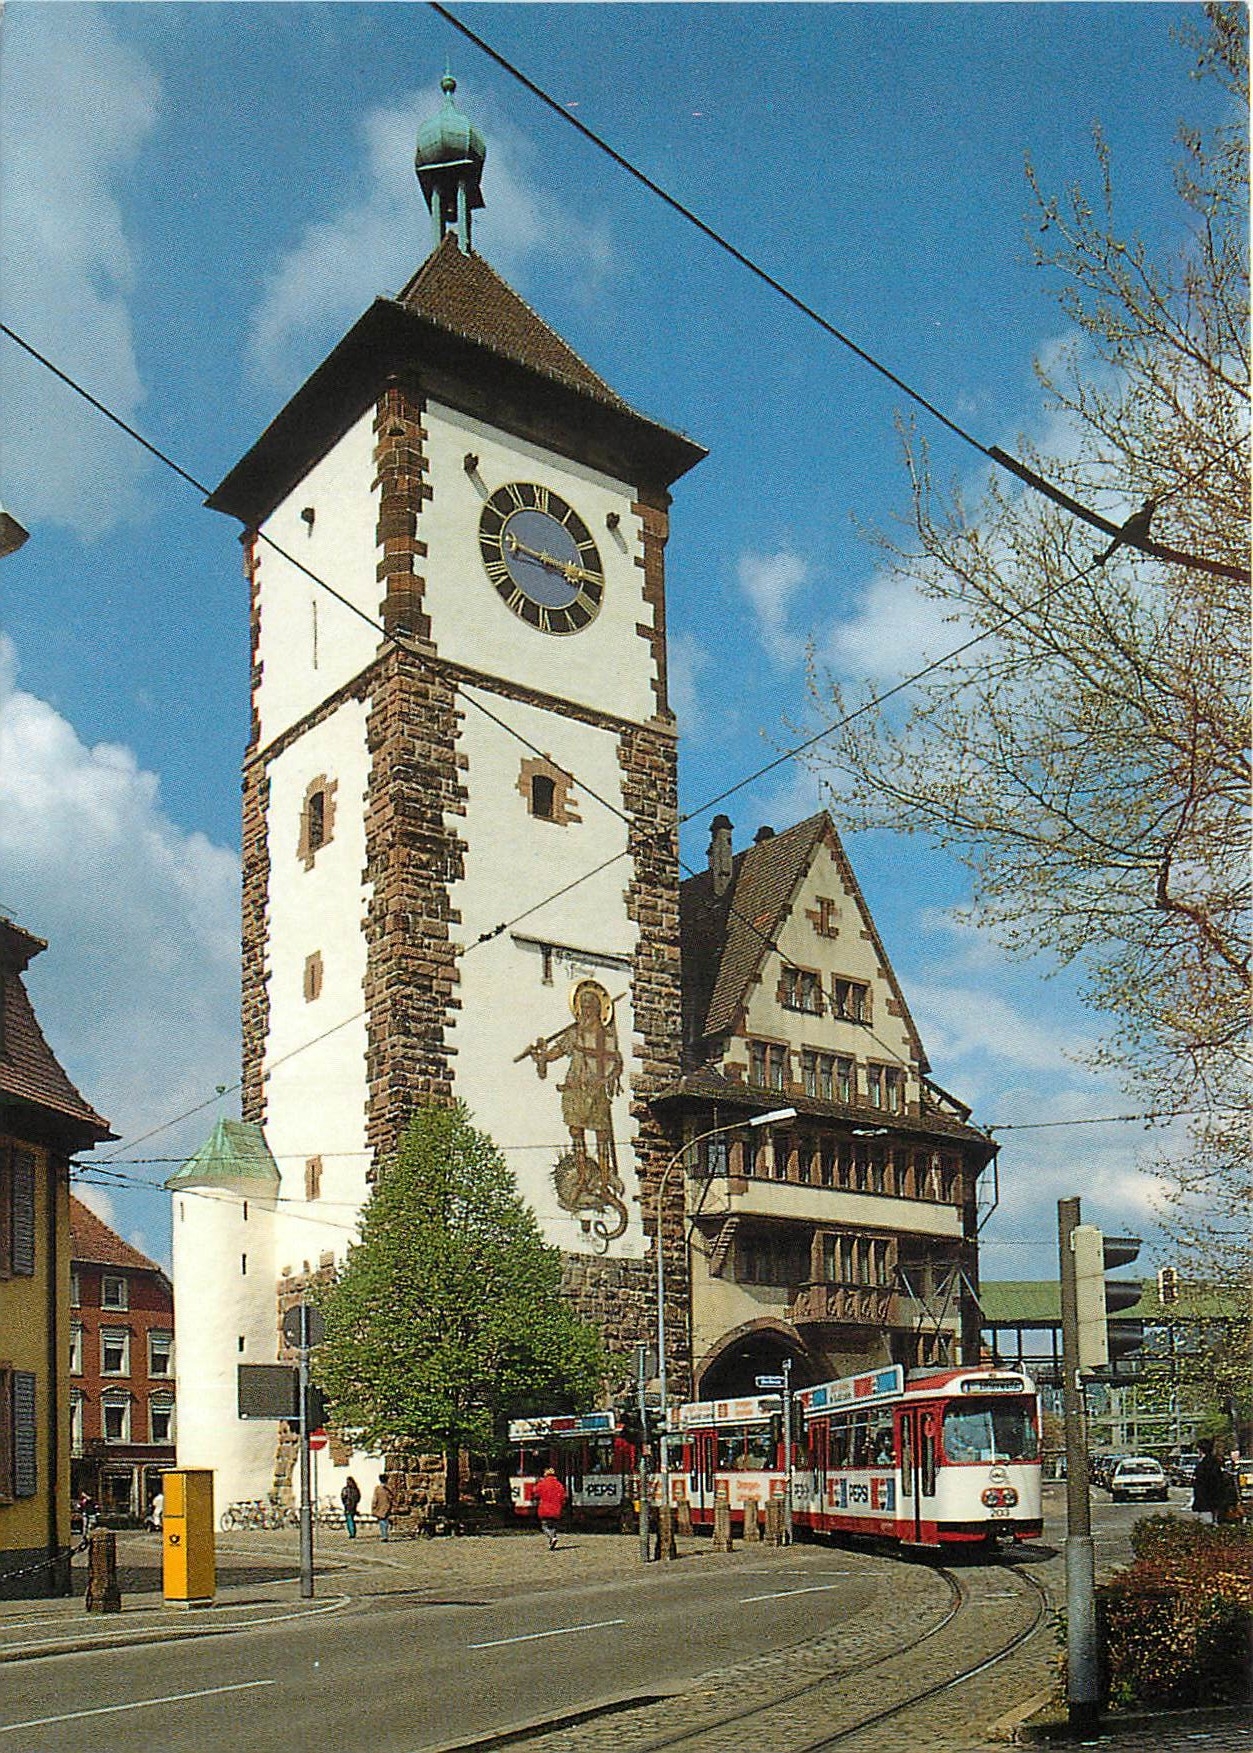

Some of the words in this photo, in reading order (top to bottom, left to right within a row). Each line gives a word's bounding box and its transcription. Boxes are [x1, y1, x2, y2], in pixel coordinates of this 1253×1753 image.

[533, 485, 549, 512] XII
[576, 539, 596, 551] II
[484, 560, 509, 586] VIII
[506, 588, 525, 615] VII
[539, 605, 552, 632] VI
[586, 1483, 617, 1497] PEPSI
